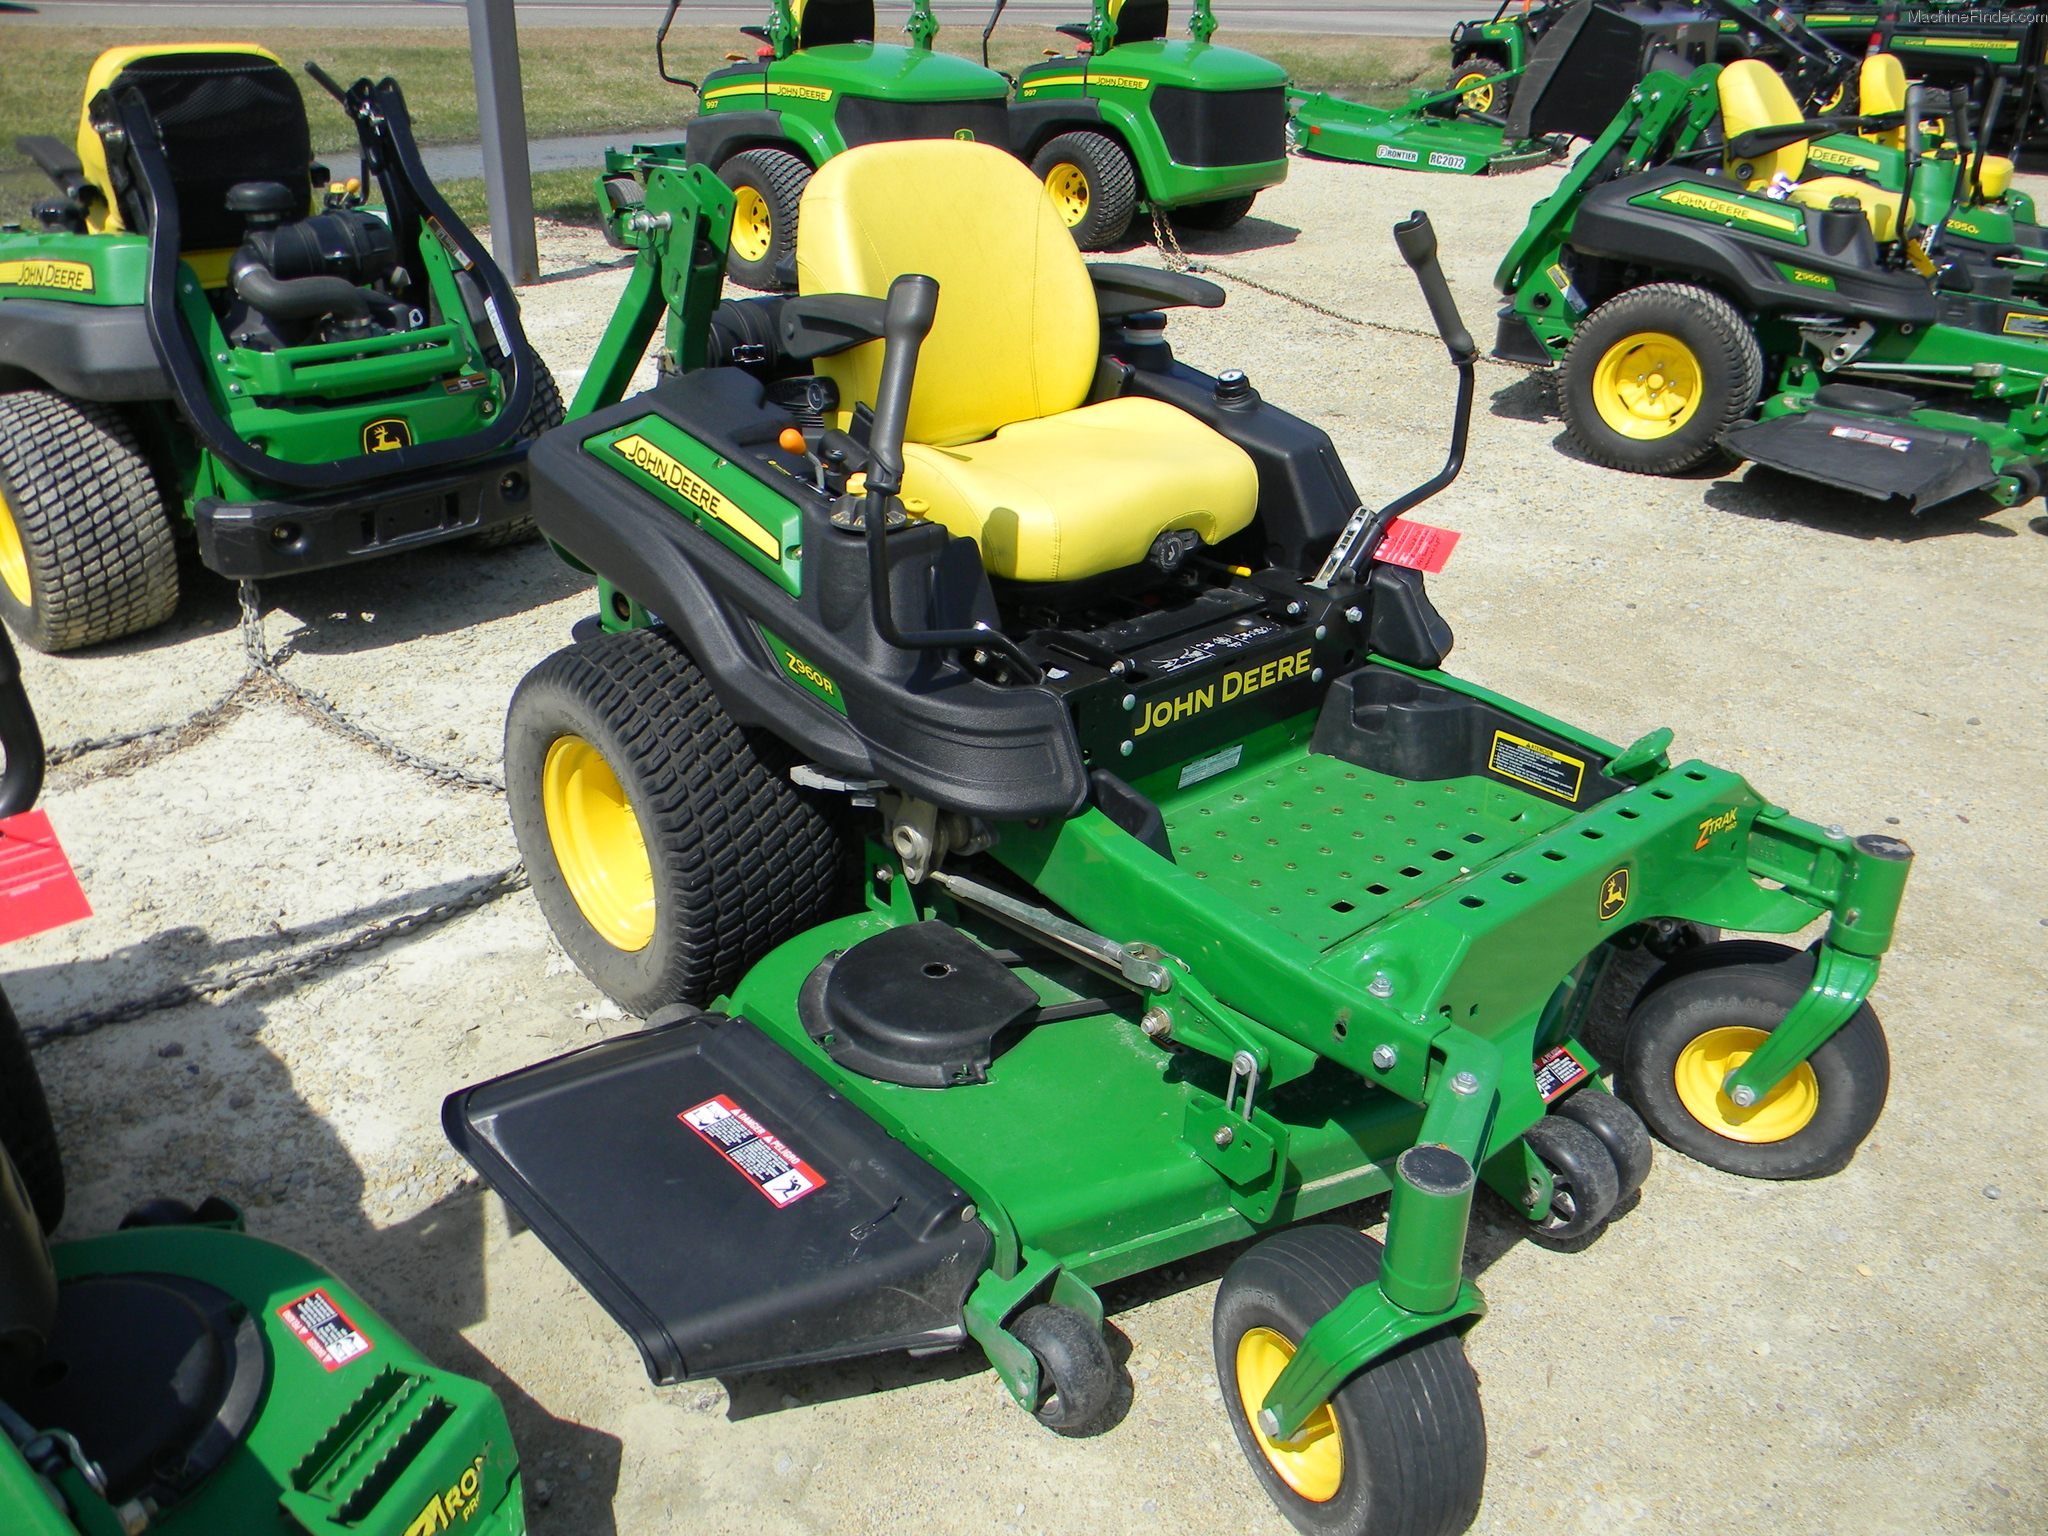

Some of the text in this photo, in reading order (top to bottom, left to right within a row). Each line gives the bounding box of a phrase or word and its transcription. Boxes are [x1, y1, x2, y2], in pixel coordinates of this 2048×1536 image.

[777, 85, 826, 100] JOHN DEERE
[1023, 89, 1037, 97] 997
[1096, 76, 1144, 89] JOHN DEERE
[705, 100, 719, 110] 997
[1377, 146, 1465, 169] FRONTIER RC2072
[1811, 150, 1856, 166] DEERE
[1675, 193, 1750, 218] JOHN DEERE
[18, 263, 85, 288] JOHN DEERE
[627, 440, 721, 515] JOHN DEERE
[785, 650, 835, 696] Z960R
[1134, 684, 1215, 737] JOHN
[1221, 648, 1312, 704] DEERE
[738, 1113, 766, 1135] DANGER
[770, 1139, 801, 1165] PELIGRO
